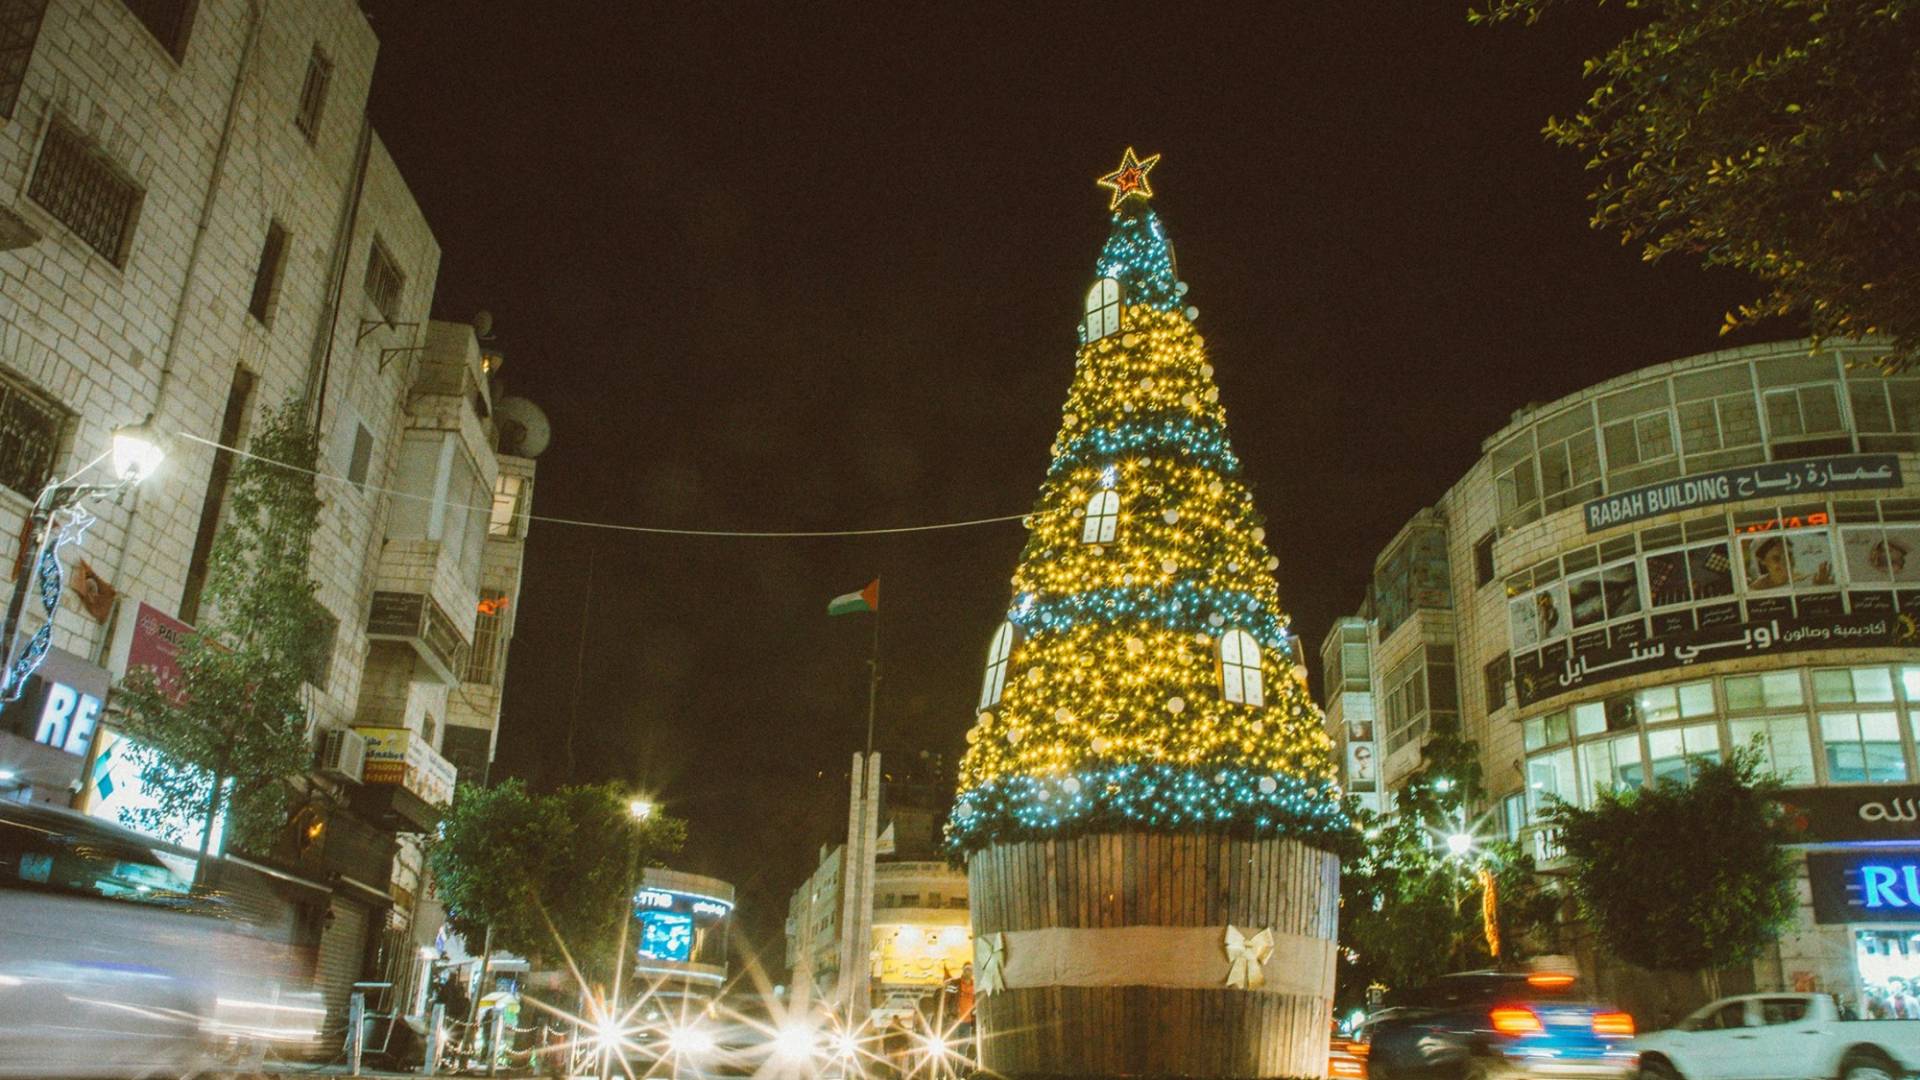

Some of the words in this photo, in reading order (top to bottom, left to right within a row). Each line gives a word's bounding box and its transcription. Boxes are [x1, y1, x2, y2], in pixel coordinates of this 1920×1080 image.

[1590, 493, 1645, 528] RABAH
[1647, 476, 1730, 513] BUILDING
[1783, 624, 1831, 642] وصالون
[1559, 641, 1665, 686] ستايل
[1859, 798, 1920, 821] لله
